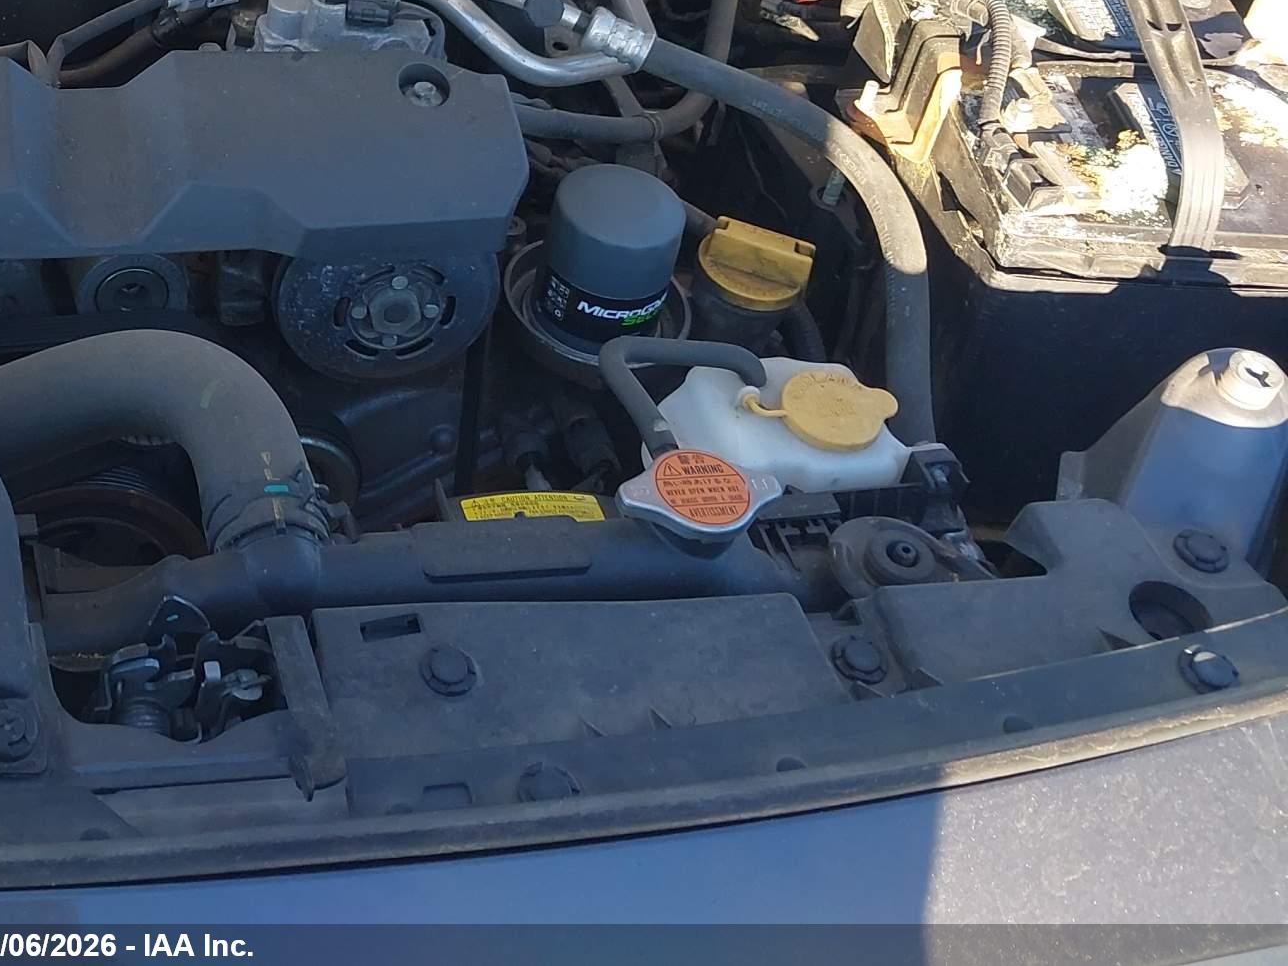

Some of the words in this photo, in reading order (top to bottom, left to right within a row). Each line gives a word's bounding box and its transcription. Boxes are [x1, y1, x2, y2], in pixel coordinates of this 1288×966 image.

[681, 464, 724, 475] WARNING
[501, 494, 531, 503] CAUTION
[534, 494, 568, 502] ATTENTION
